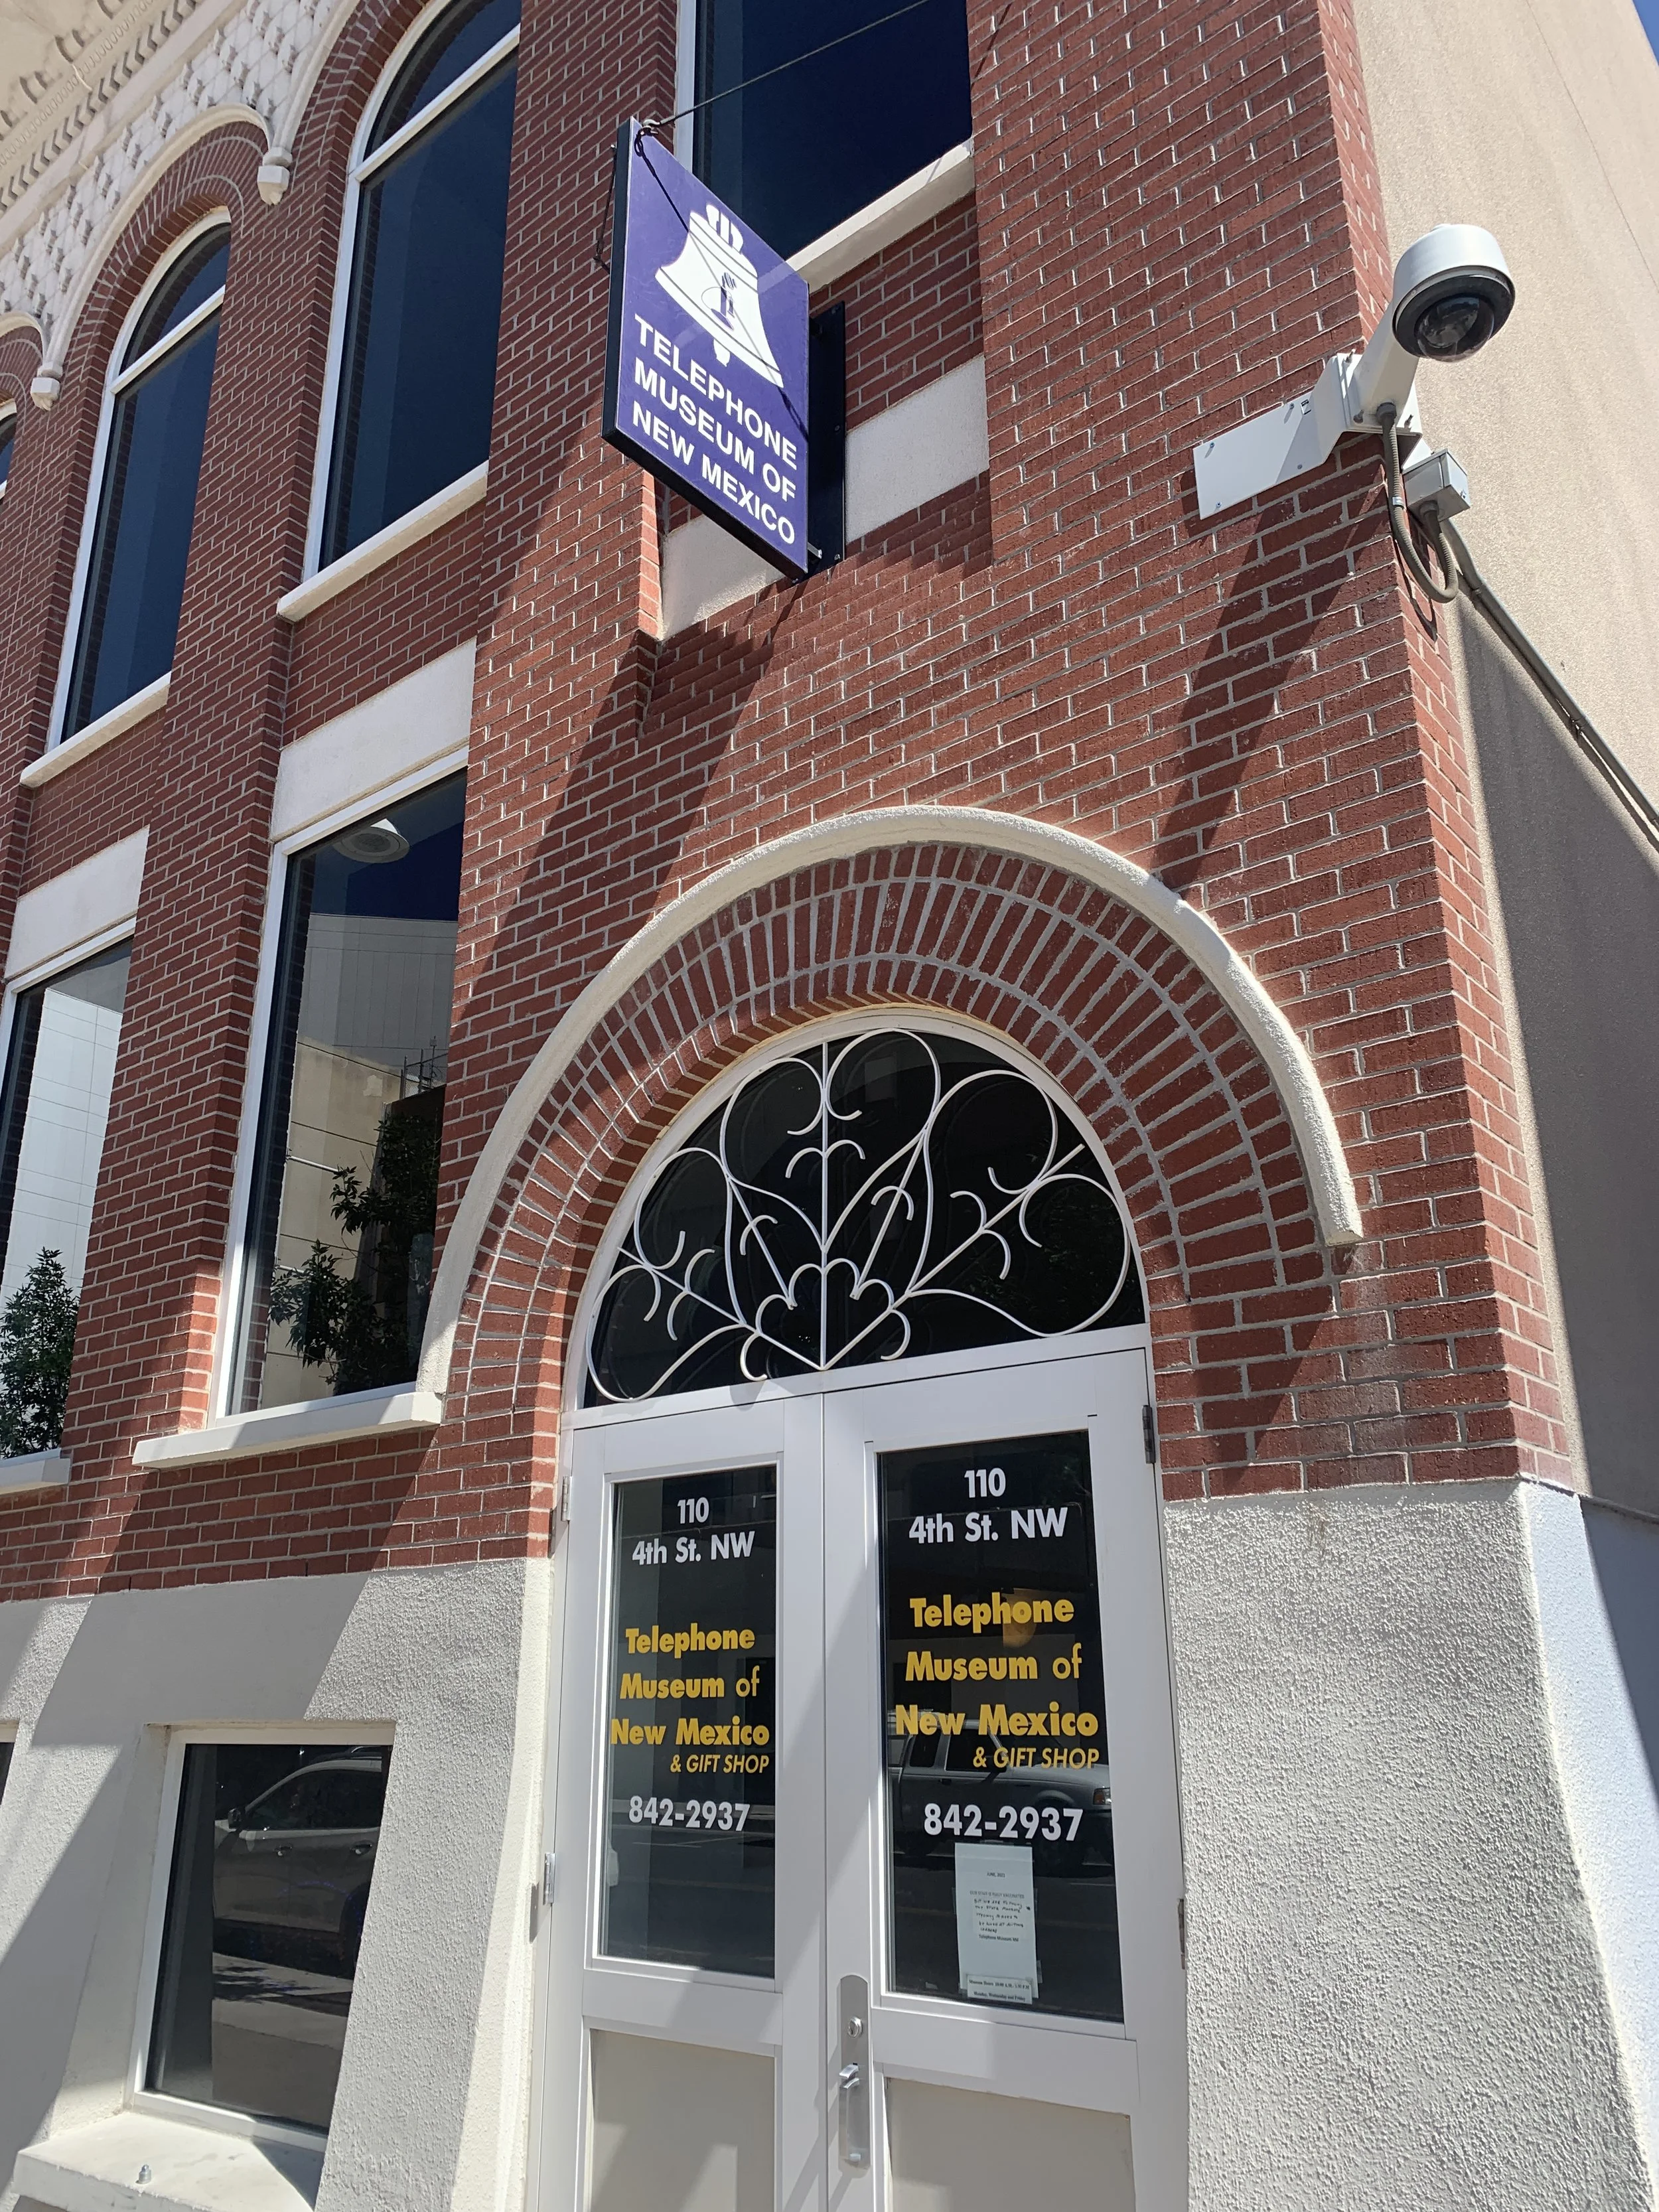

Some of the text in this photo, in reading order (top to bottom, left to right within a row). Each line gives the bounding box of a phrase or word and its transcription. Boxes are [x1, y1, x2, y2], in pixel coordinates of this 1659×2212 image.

[634, 313, 796, 470] TELEPHONE
[634, 356, 796, 502] MUSEUM OF
[632, 400, 795, 545] NEW MEXICO
[964, 1467, 1006, 1498] 110
[677, 1497, 709, 1524] 110
[908, 1507, 1068, 1544] 4th St. NW
[632, 1530, 755, 1566] 4th St. NW
[909, 1591, 1074, 1634] Telephone
[625, 1623, 755, 1659] Telephone
[905, 1643, 1082, 1681] Museum of
[620, 1665, 760, 1699] Museum of
[611, 1715, 770, 1745] New Mexico
[895, 1701, 1098, 1736] New Mexico
[670, 1754, 769, 1774] & GIFT SHOP
[973, 1747, 1099, 1769] & GIFT SHOP
[629, 1795, 751, 1832] 842-2937
[924, 1803, 1083, 1842] 842-2937
